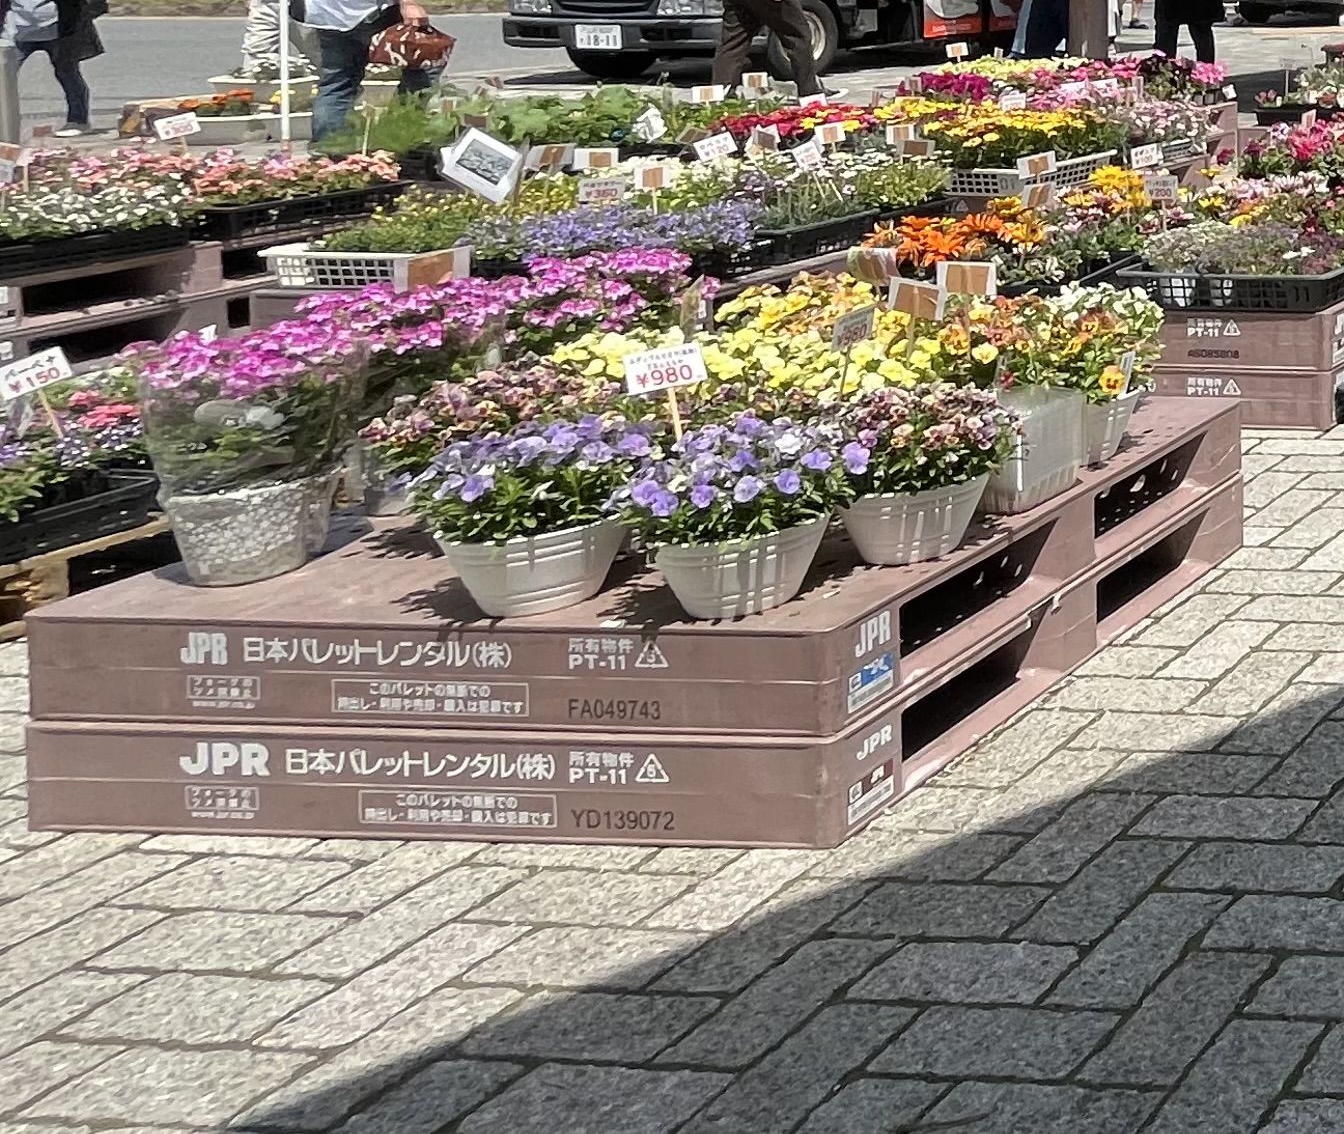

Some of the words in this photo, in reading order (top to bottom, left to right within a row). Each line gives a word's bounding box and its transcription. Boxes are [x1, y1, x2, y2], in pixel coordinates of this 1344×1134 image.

[1187, 328, 1220, 338] PT-11
[7, 367, 61, 394] ¥150
[635, 363, 694, 389] ¥980
[1187, 387, 1220, 397] PT-11
[855, 609, 891, 658] JPR
[180, 631, 228, 666] JPR
[242, 636, 512, 669] 日本パレットレンタル(株)
[568, 654, 626, 671] PT-11
[568, 698, 662, 720] FA049743
[855, 724, 893, 761] JPR
[178, 742, 271, 777] JPR
[285, 748, 557, 781] 日本パレットレンタル(株)
[568, 768, 628, 785] PT-11
[571, 809, 676, 831] YD139072
